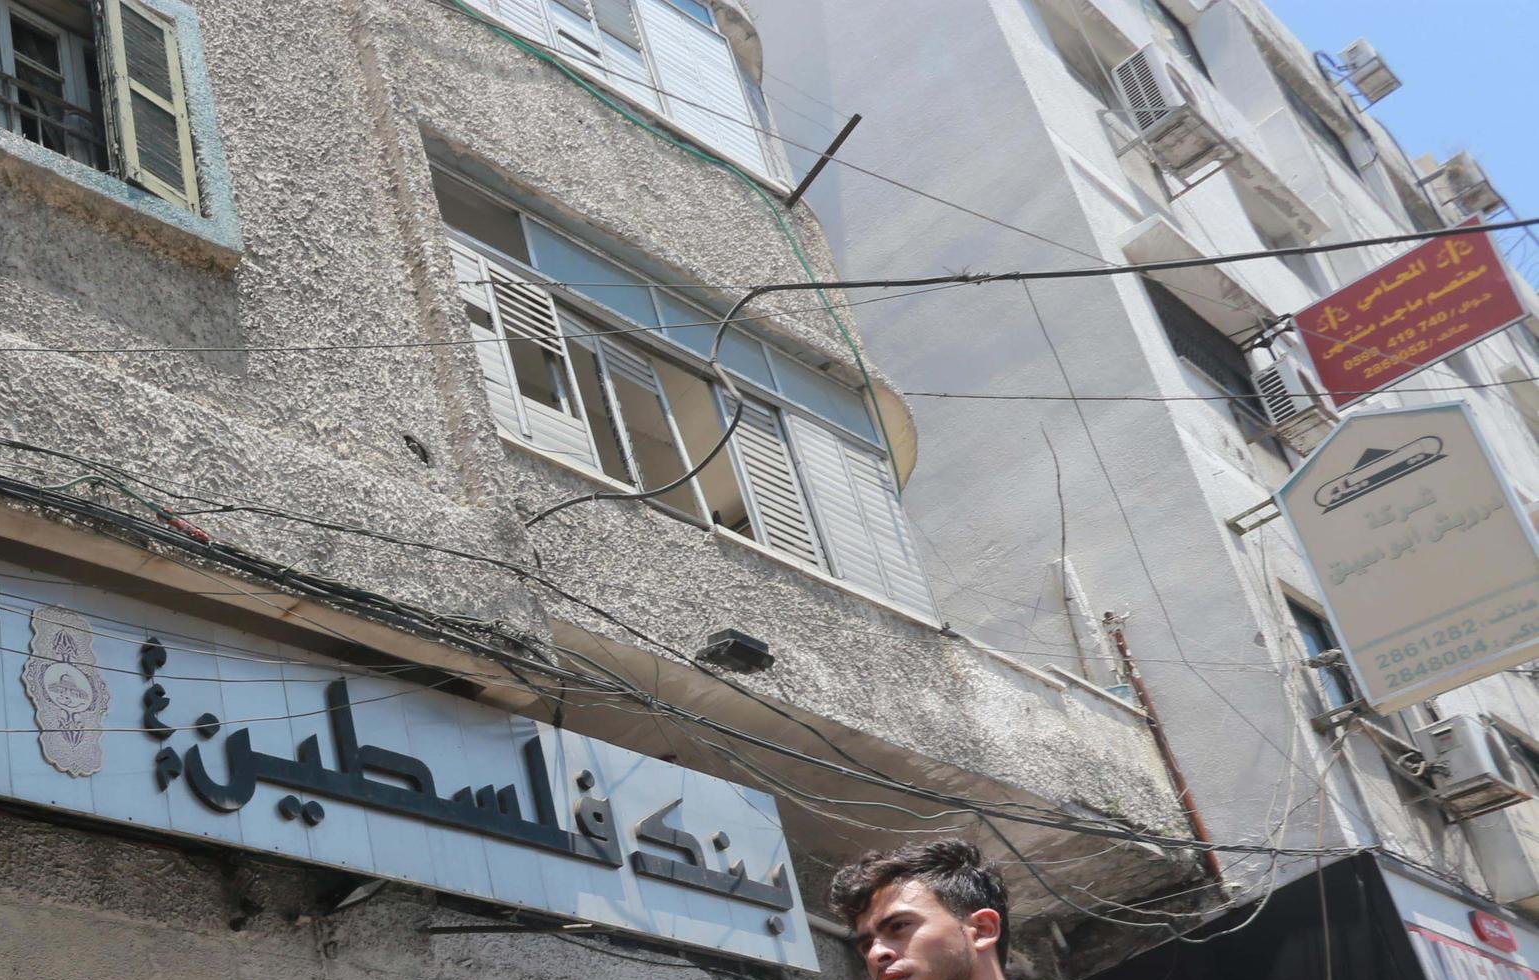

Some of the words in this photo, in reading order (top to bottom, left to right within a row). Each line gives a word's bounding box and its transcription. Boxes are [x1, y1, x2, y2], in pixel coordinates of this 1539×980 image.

[1356, 258, 1427, 312] المحامي
[1387, 325, 1417, 349] 419
[1418, 310, 1448, 333] 740
[1363, 485, 1438, 530] شركة
[1375, 618, 1479, 670] 2861282
[183, 676, 625, 870] فلسطين
[631, 797, 796, 937] بنك
